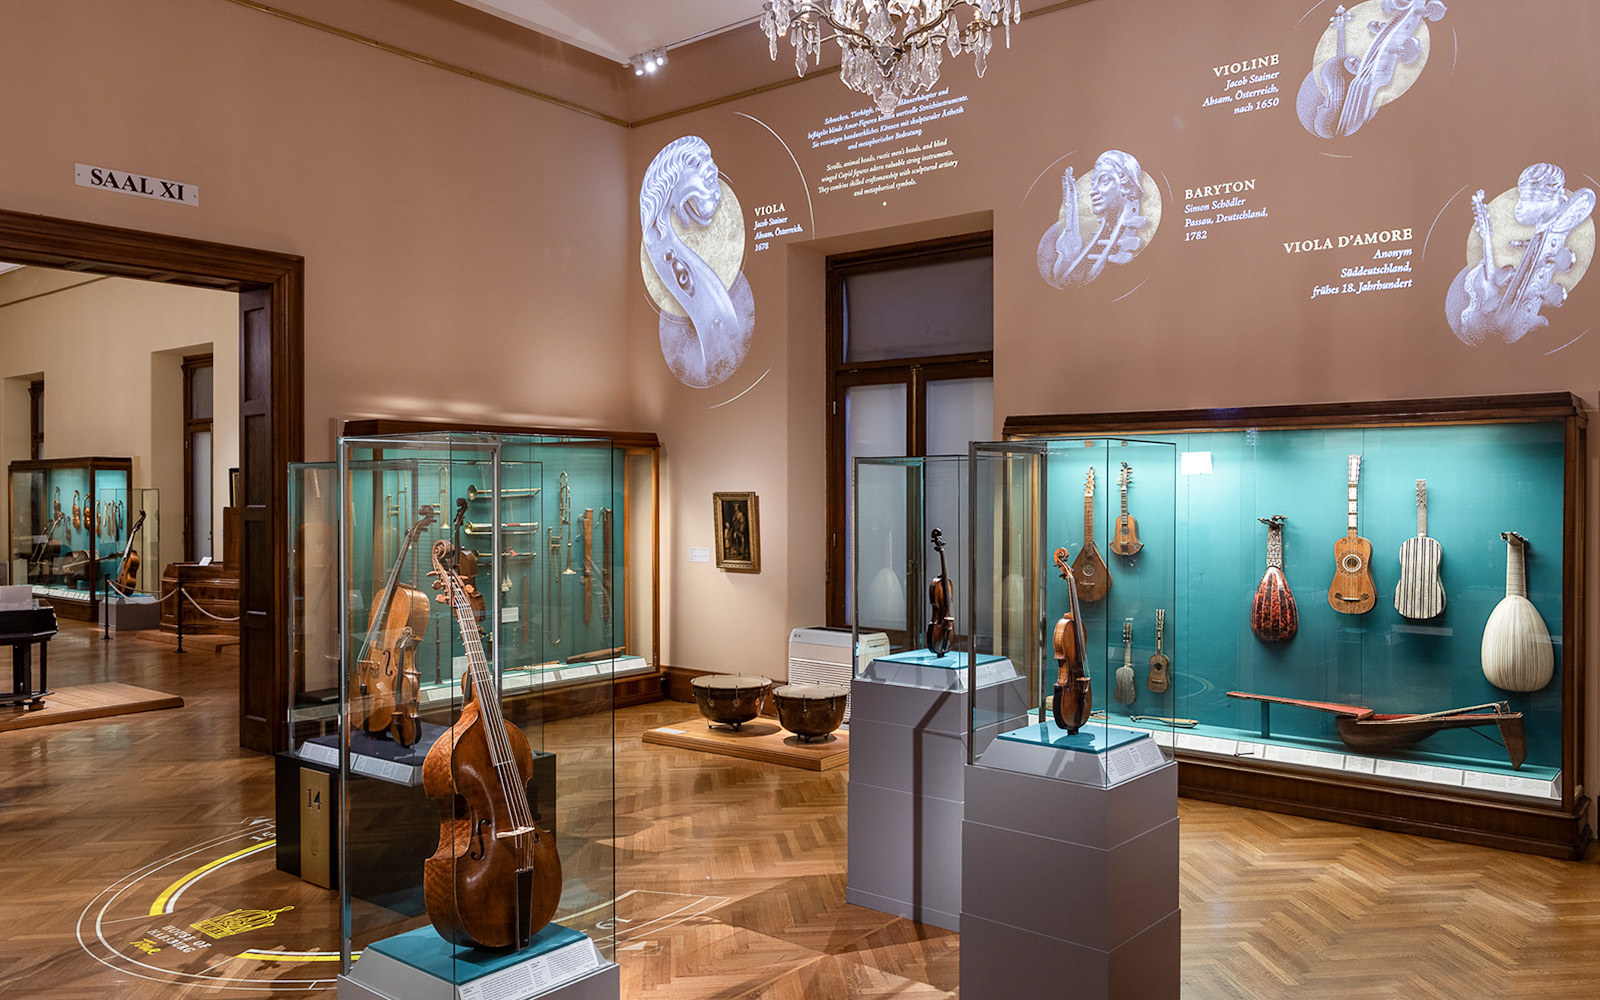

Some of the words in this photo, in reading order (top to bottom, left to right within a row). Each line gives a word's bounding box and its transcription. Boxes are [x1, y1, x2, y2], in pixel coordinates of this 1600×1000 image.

[1213, 53, 1280, 77] VIOLINE
[938, 86, 950, 96] und
[1224, 76, 1248, 91] Jacob
[1249, 71, 1280, 84] Stainer
[1202, 96, 1233, 108] Absam,
[1235, 83, 1279, 100] Österreich,
[1233, 102, 1254, 114] nach
[1255, 97, 1280, 110] 1650
[896, 106, 919, 118] wertvolle
[820, 136, 843, 146] vereinigen
[880, 123, 900, 132] Können
[900, 119, 909, 127] mit
[910, 112, 941, 125] skulpturaler
[843, 157, 860, 167] animal
[876, 151, 890, 160] rustic
[922, 141, 933, 150] and
[933, 137, 948, 148] blind
[847, 141, 858, 150] und
[858, 133, 894, 148] metaphorischer
[818, 186, 830, 194] They
[830, 182, 849, 191] combine
[849, 177, 865, 187] skilled
[865, 171, 898, 184] craftsmanship
[899, 168, 911, 177] with
[938, 160, 959, 169] artistry
[821, 172, 837, 183] winged
[838, 169, 853, 180] Cupid
[852, 168, 869, 178] figures
[869, 164, 884, 172] adorn
[885, 158, 906, 169] valuable
[906, 156, 921, 165] string
[90, 167, 154, 195] SAAL
[159, 180, 185, 201] XI
[853, 187, 864, 197] and
[864, 182, 895, 195] metaphorical
[1184, 178, 1256, 200] BARYTON
[754, 202, 786, 217] VIOLA
[1184, 204, 1210, 214] Simon
[1211, 196, 1247, 210] Schödler
[753, 218, 769, 231] Jacob
[769, 216, 789, 226] Stainer
[1184, 217, 1214, 228] Passau,
[1215, 206, 1269, 223] Deutschland,
[1184, 230, 1208, 242] 1782
[1283, 237, 1334, 254] VIOLA
[1337, 227, 1413, 248] D'AMORE
[1372, 248, 1413, 260] Anonym
[1340, 260, 1412, 278] Süddeutschland,
[1310, 284, 1340, 299] frühes
[1341, 283, 1356, 294] 18.
[1356, 277, 1413, 295] Jahrhundert
[307, 788, 322, 812] 14
[161, 924, 197, 942] HOUSE
[192, 940, 213, 949] OF
